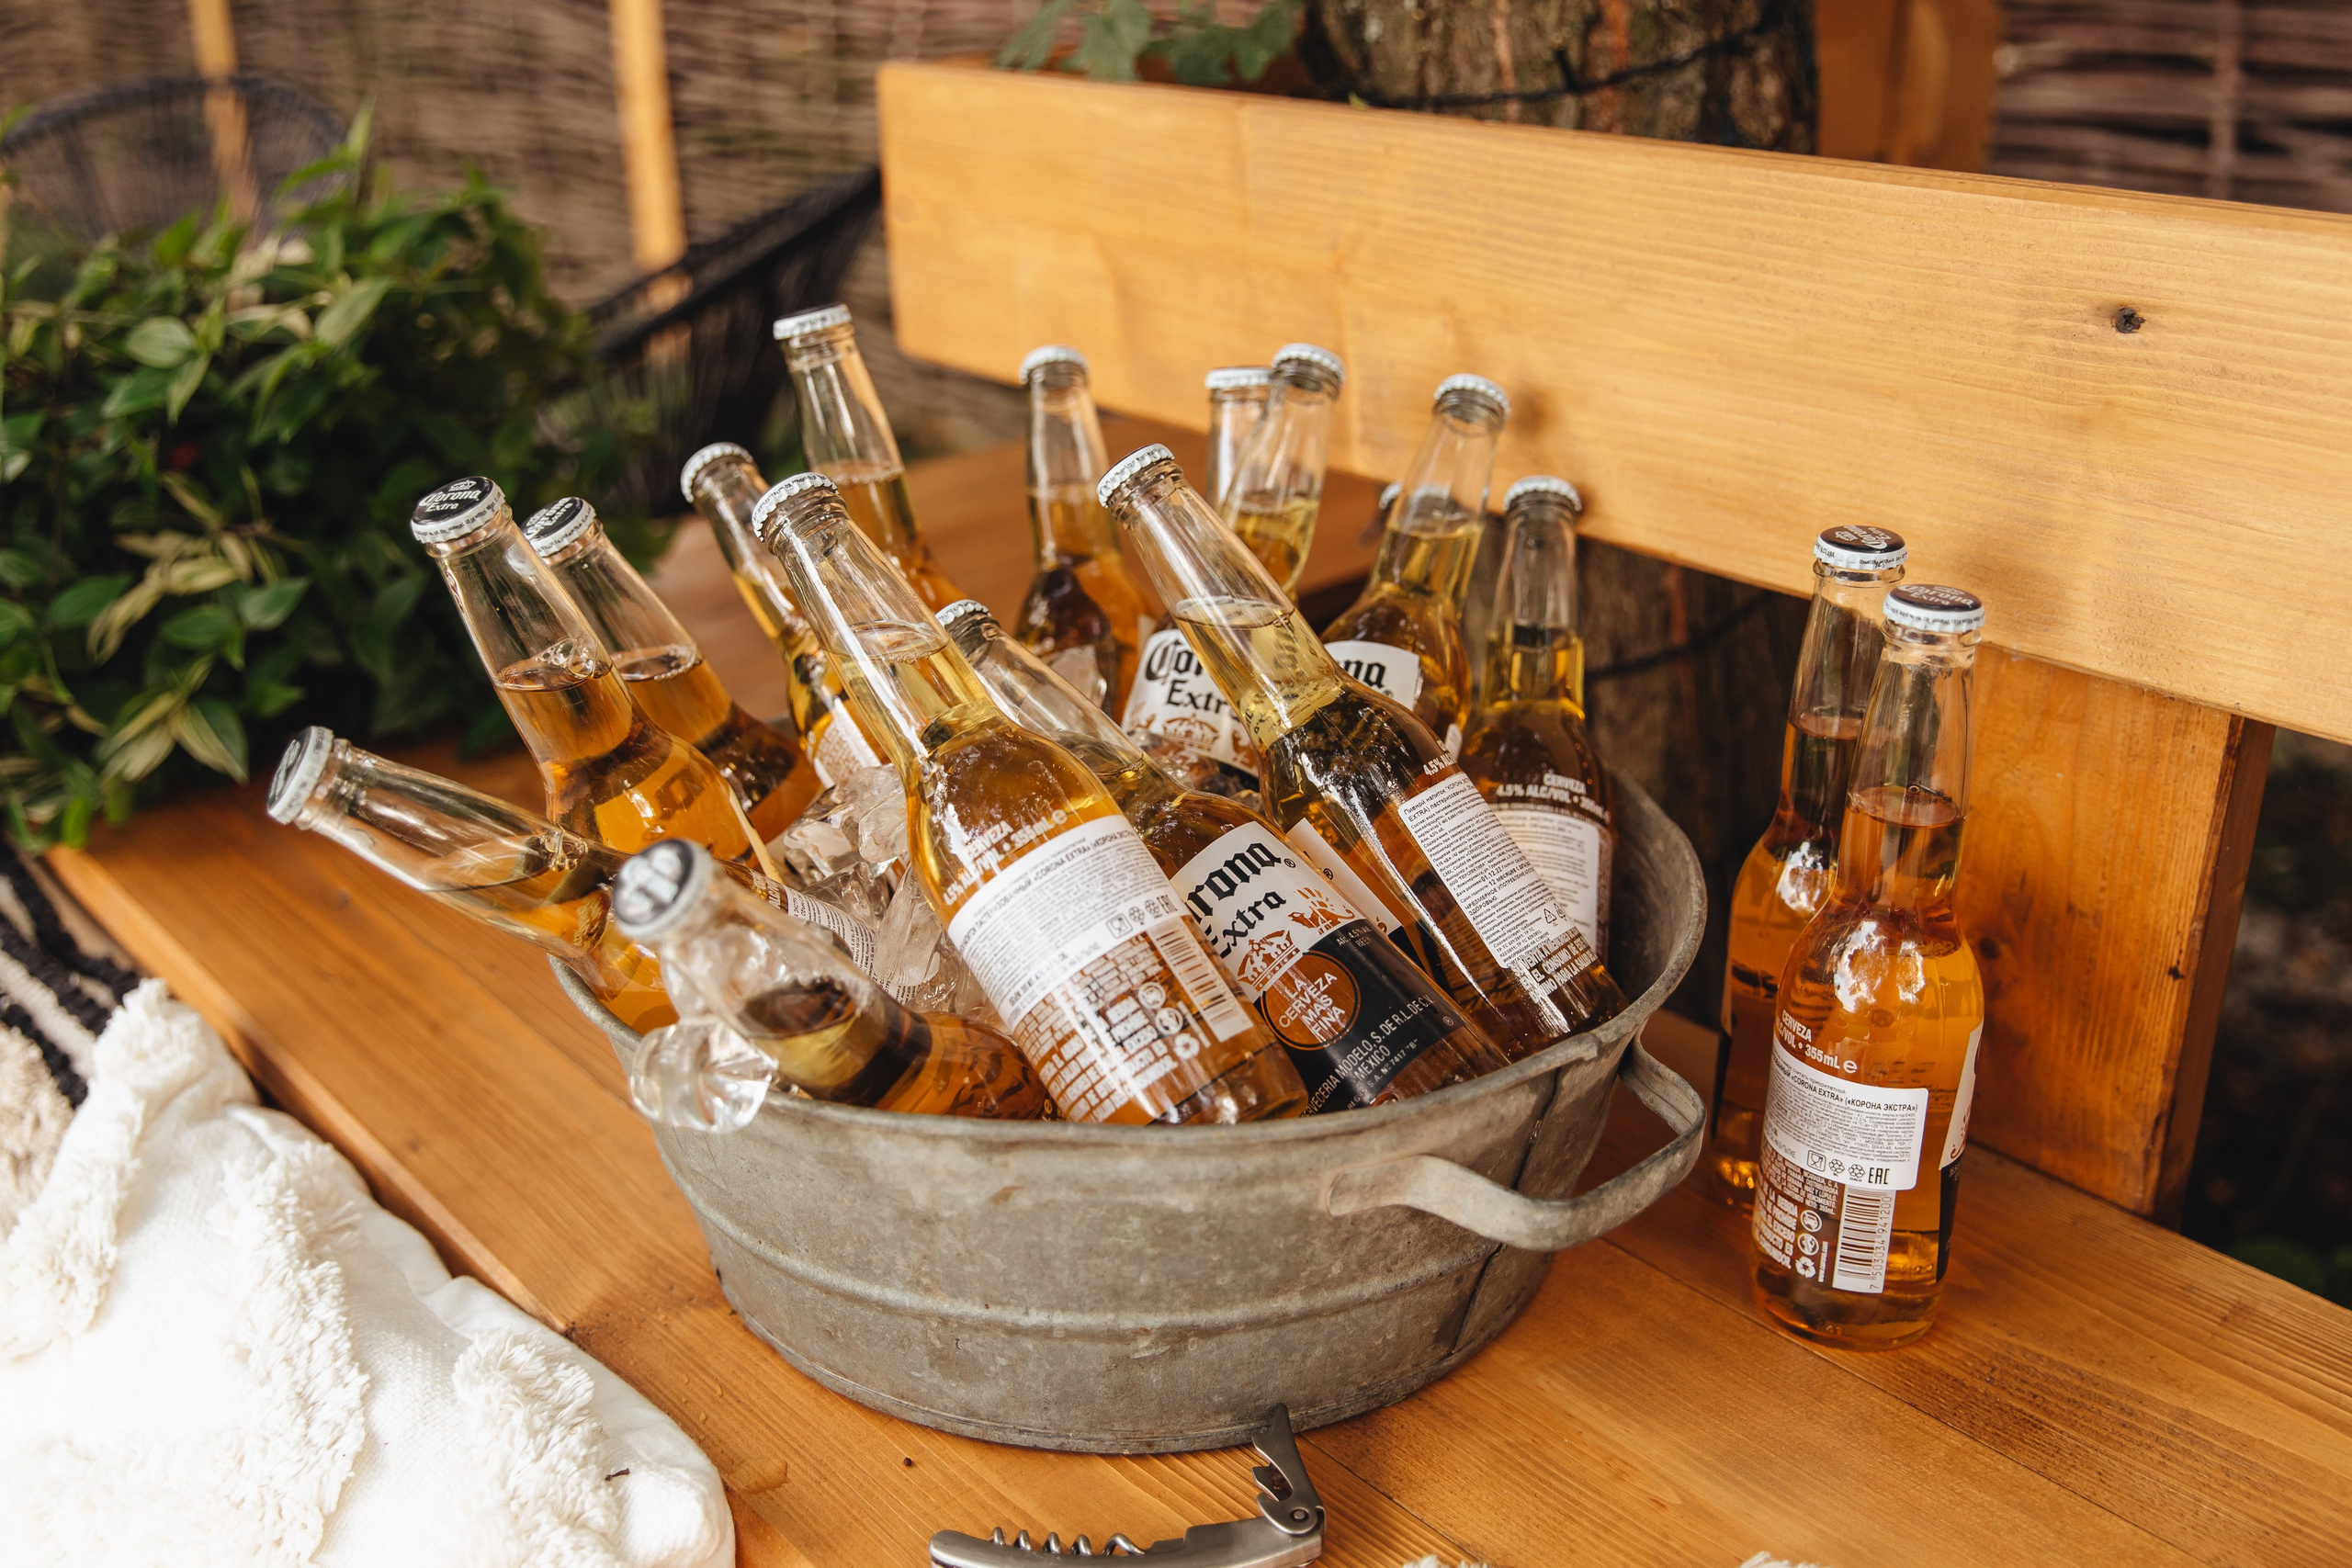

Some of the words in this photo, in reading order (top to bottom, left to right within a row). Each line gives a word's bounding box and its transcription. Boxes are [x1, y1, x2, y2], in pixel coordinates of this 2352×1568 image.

[418, 489, 482, 507] Corona
[425, 501, 459, 513] Extra
[1898, 584, 1974, 606] Corona
[1909, 592, 1951, 606] Extra
[1145, 639, 1203, 685] Cor
[1166, 678, 1238, 722] Extr
[1423, 756, 1445, 775] 4.5%
[1404, 800, 1426, 816] Пивной
[1426, 789, 1446, 802] напиток
[1496, 784, 1525, 797] 4.5%
[1408, 807, 1430, 822] EXTRA)
[943, 880, 965, 906] 4.5%
[1011, 816, 1057, 848] 355mL
[1035, 858, 1066, 881] «CORONA
[1066, 846, 1091, 862] EXTRA»
[1481, 866, 1503, 883] 01.12.22
[1460, 896, 1472, 904] Срок
[1496, 868, 1517, 882] месяцев
[1465, 887, 1498, 909] ЧРЕЗМЕРНОЕ
[1468, 896, 1498, 916] ЗДОРОВЬЮ.
[1472, 908, 1491, 921] Алкоголь
[1337, 936, 1351, 946] Alc.
[1521, 948, 1545, 970] VENTA
[1542, 946, 1551, 957] A
[1532, 968, 1545, 982] EL
[1542, 949, 1571, 975] CONSUMO
[1567, 942, 1579, 956] DE
[1553, 967, 1573, 986] PARA
[1567, 963, 1580, 976] LA
[1575, 953, 1591, 970] SALUD
[1279, 972, 1337, 1028] CERVEZA
[1285, 978, 1306, 998] LA
[1302, 994, 1333, 1026] MAS
[1309, 1006, 1346, 1042] FINA
[1782, 1010, 1812, 1042] CERVEZA
[1301, 1075, 1341, 1118] ERVECERIA
[1335, 1039, 1377, 1078] MODELO,
[1370, 1031, 1385, 1044] S.
[1380, 1020, 1397, 1036] DE
[1353, 1044, 1391, 1082] MEXICO
[1390, 1049, 1408, 1066] 7417
[1805, 1043, 1840, 1070] 355mL
[1792, 1075, 1818, 1093] «CORONA
[1818, 1088, 1844, 1102] EXTRA»
[1845, 1097, 1882, 1111] («КОРОНА
[1883, 1103, 1918, 1112] ЭКСТРА»)
[1868, 1167, 1890, 1184] EAC
[1877, 1195, 1892, 1235] 941200
[1871, 1240, 1886, 1277] 503034
